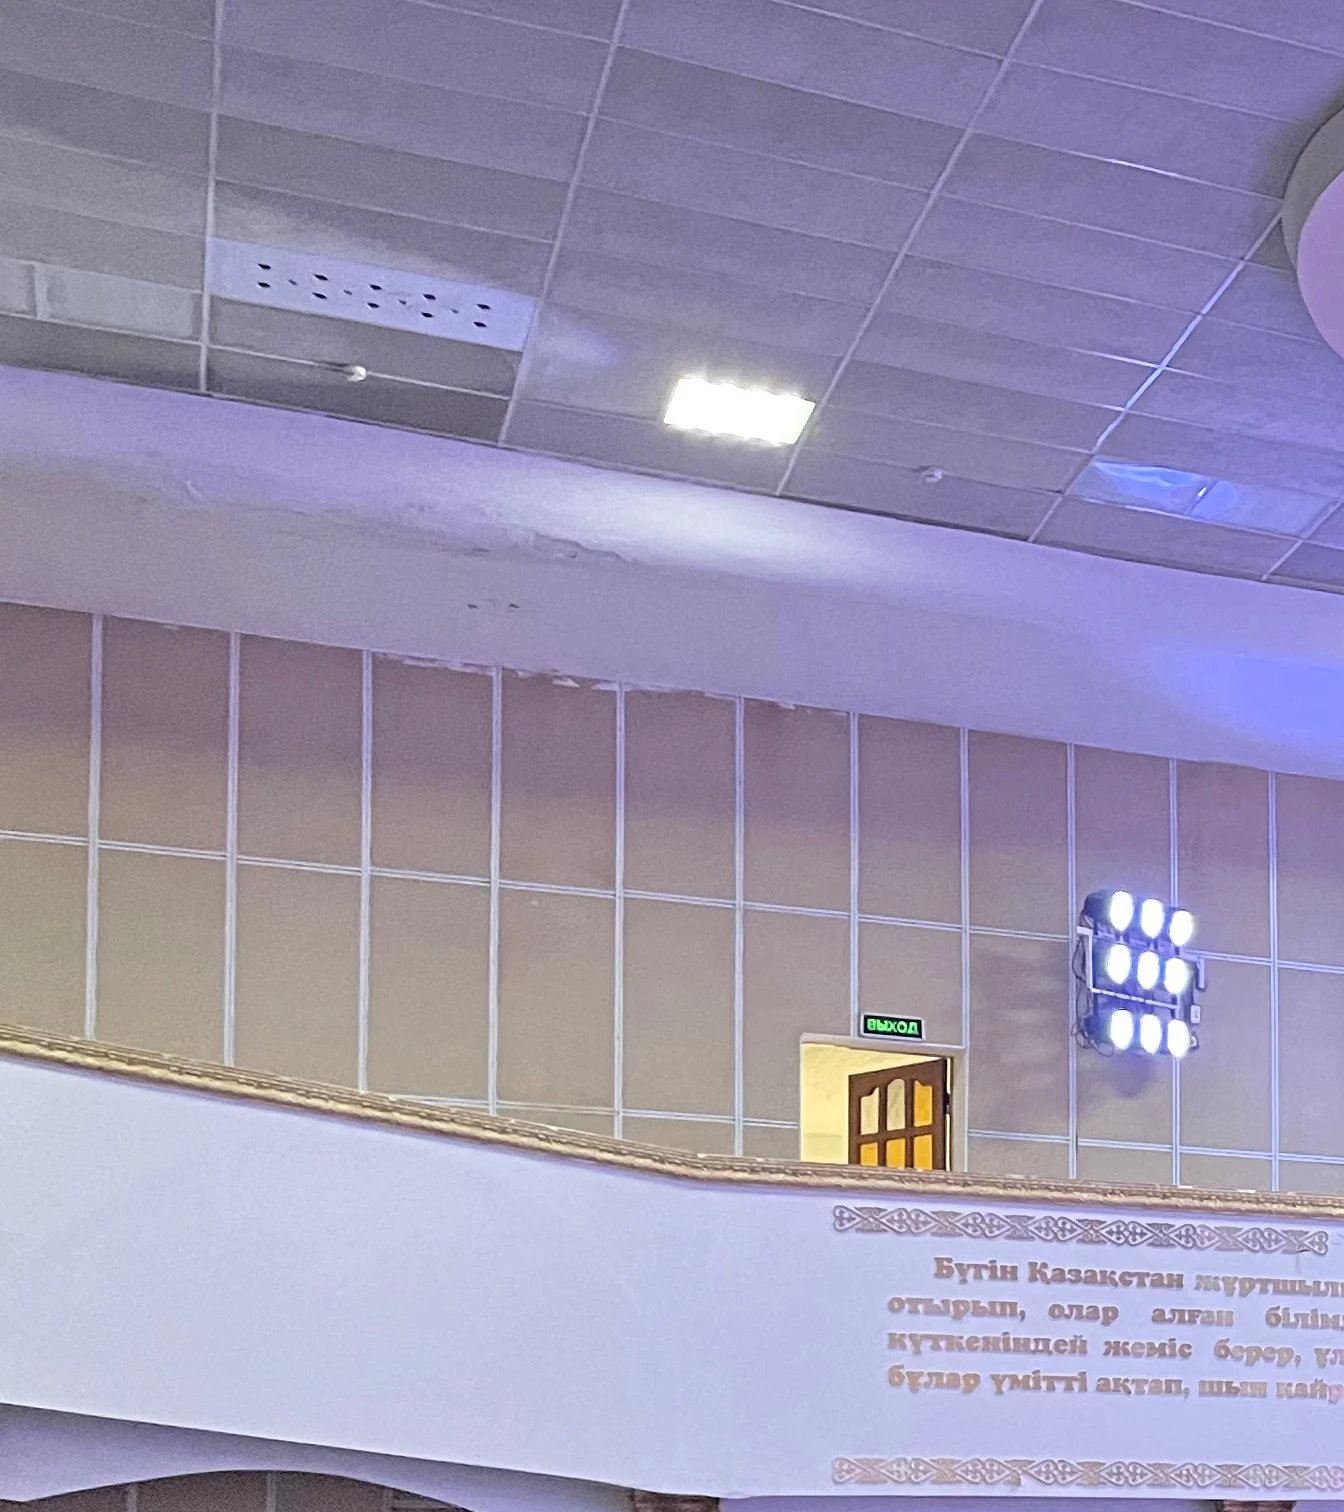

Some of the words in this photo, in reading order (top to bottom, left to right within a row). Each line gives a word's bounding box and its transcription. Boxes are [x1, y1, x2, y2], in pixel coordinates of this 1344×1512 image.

[867, 1018, 919, 1036] ВЫХОД
[933, 1257, 1018, 1285] Бүгін
[1028, 1261, 1184, 1290] Қазақстан
[887, 1297, 1026, 1322] отырып,
[1048, 1303, 1119, 1326] олар
[1151, 1307, 1234, 1328] алған
[887, 1331, 1088, 1356] күткеніндей
[1103, 1337, 1192, 1359] жеміс
[1214, 1338, 1302, 1368] берер,
[887, 1364, 981, 1393] бұлар
[991, 1370, 1088, 1395] үмітті
[1096, 1375, 1190, 1399] ақтап,
